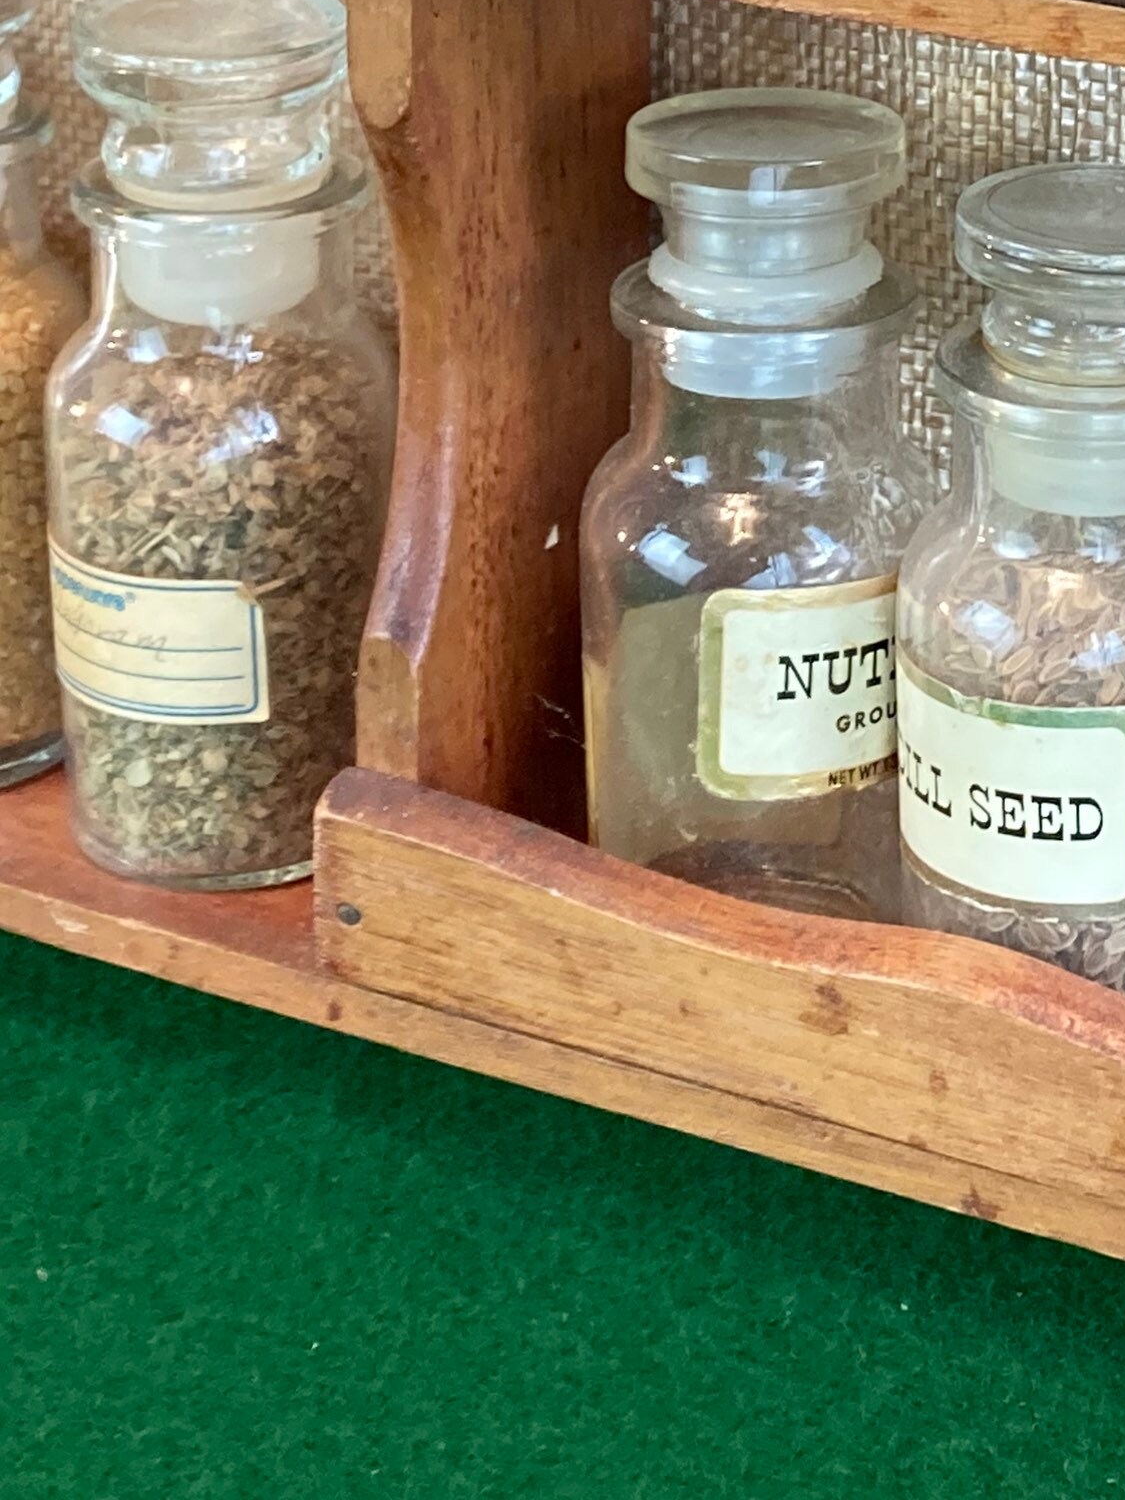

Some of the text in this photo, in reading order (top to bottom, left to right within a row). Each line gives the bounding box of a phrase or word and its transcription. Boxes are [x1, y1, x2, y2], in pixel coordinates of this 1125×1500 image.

[777, 635, 897, 700] NUT
[827, 768, 855, 787] NET
[858, 761, 879, 781] WT
[969, 783, 1104, 842] SEED
